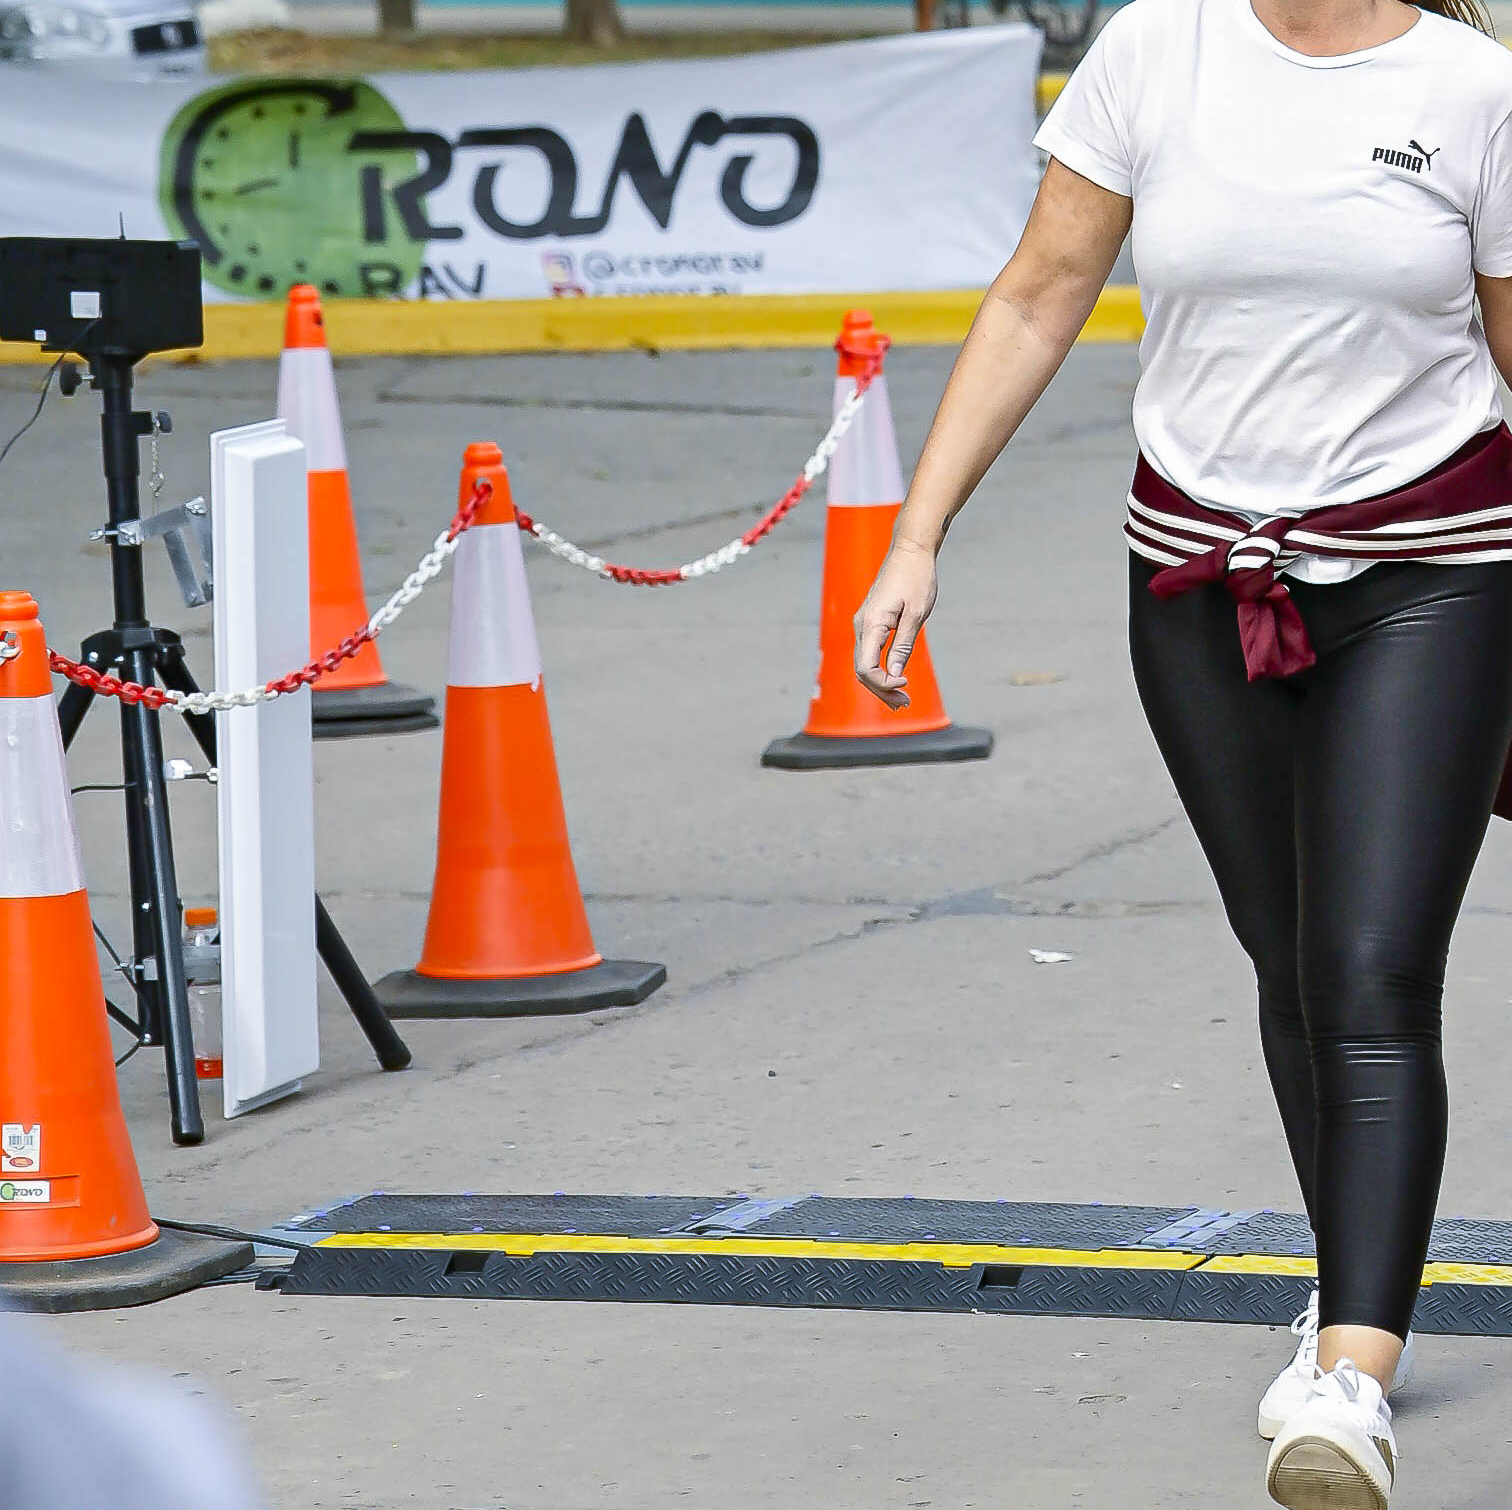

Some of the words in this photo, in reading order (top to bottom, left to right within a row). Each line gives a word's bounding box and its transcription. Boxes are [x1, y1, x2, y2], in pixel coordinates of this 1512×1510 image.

[173, 78, 819, 264] CRONO
[1372, 147, 1423, 173] PUMA
[359, 261, 485, 300] RAV
